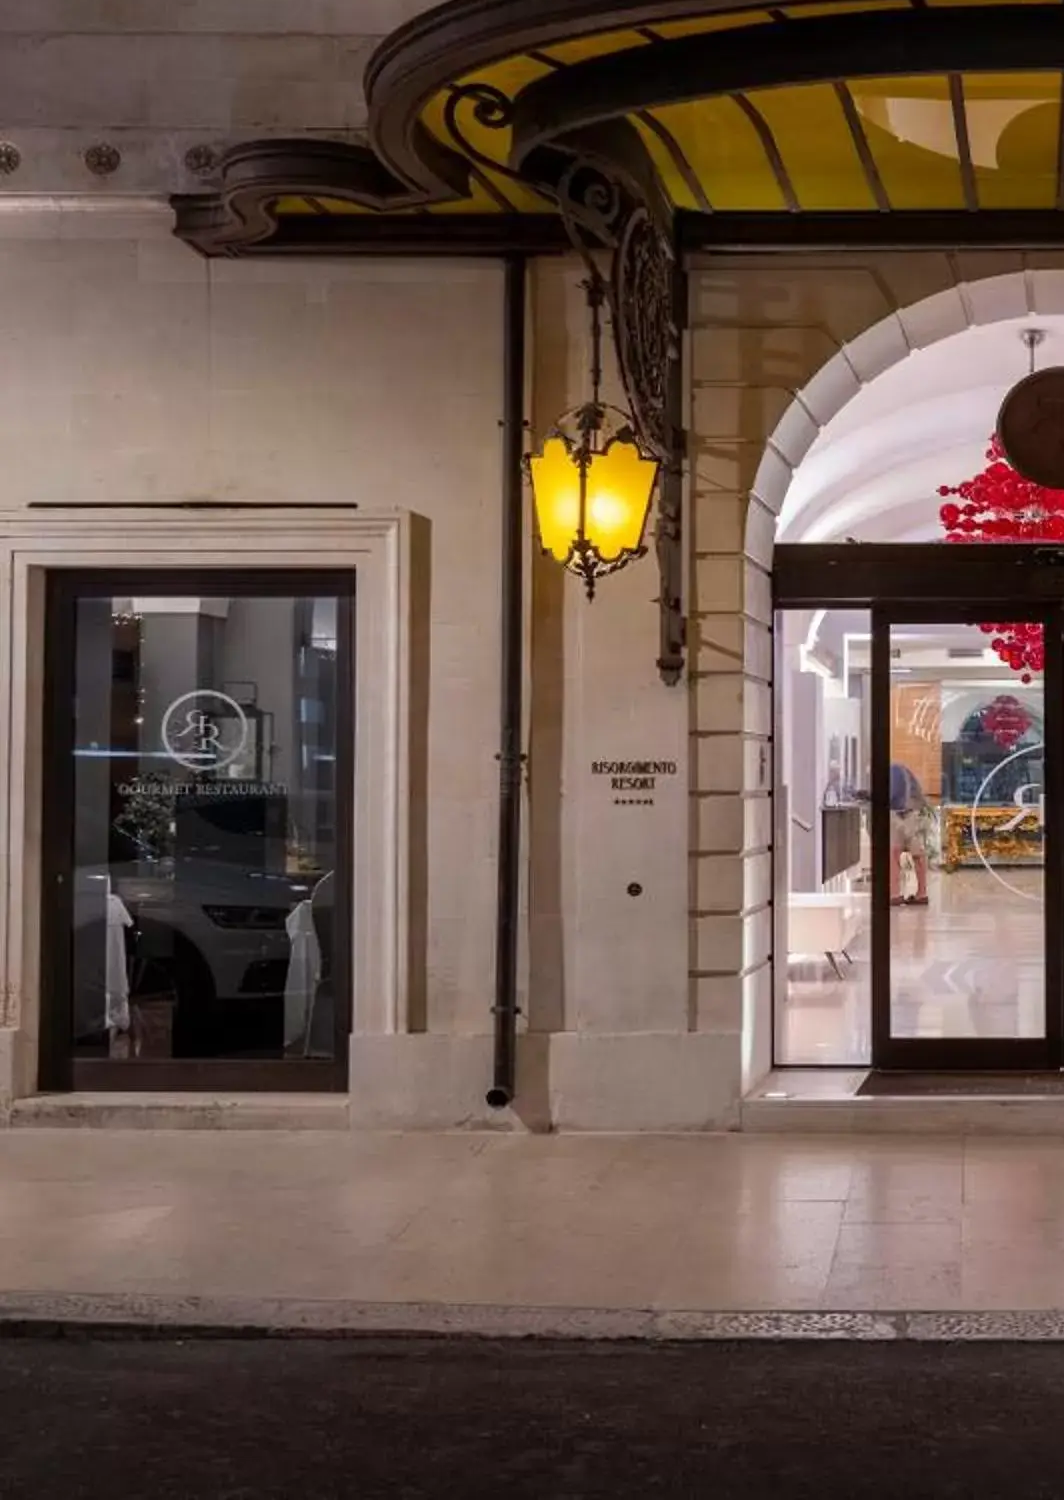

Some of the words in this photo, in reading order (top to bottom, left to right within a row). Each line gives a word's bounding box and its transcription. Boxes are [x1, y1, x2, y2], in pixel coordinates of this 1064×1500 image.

[591, 761, 677, 774] RISORGIMENTO
[117, 782, 192, 795] GOURMET
[196, 782, 288, 795] RESTAURANT
[611, 777, 655, 790] RESORT
